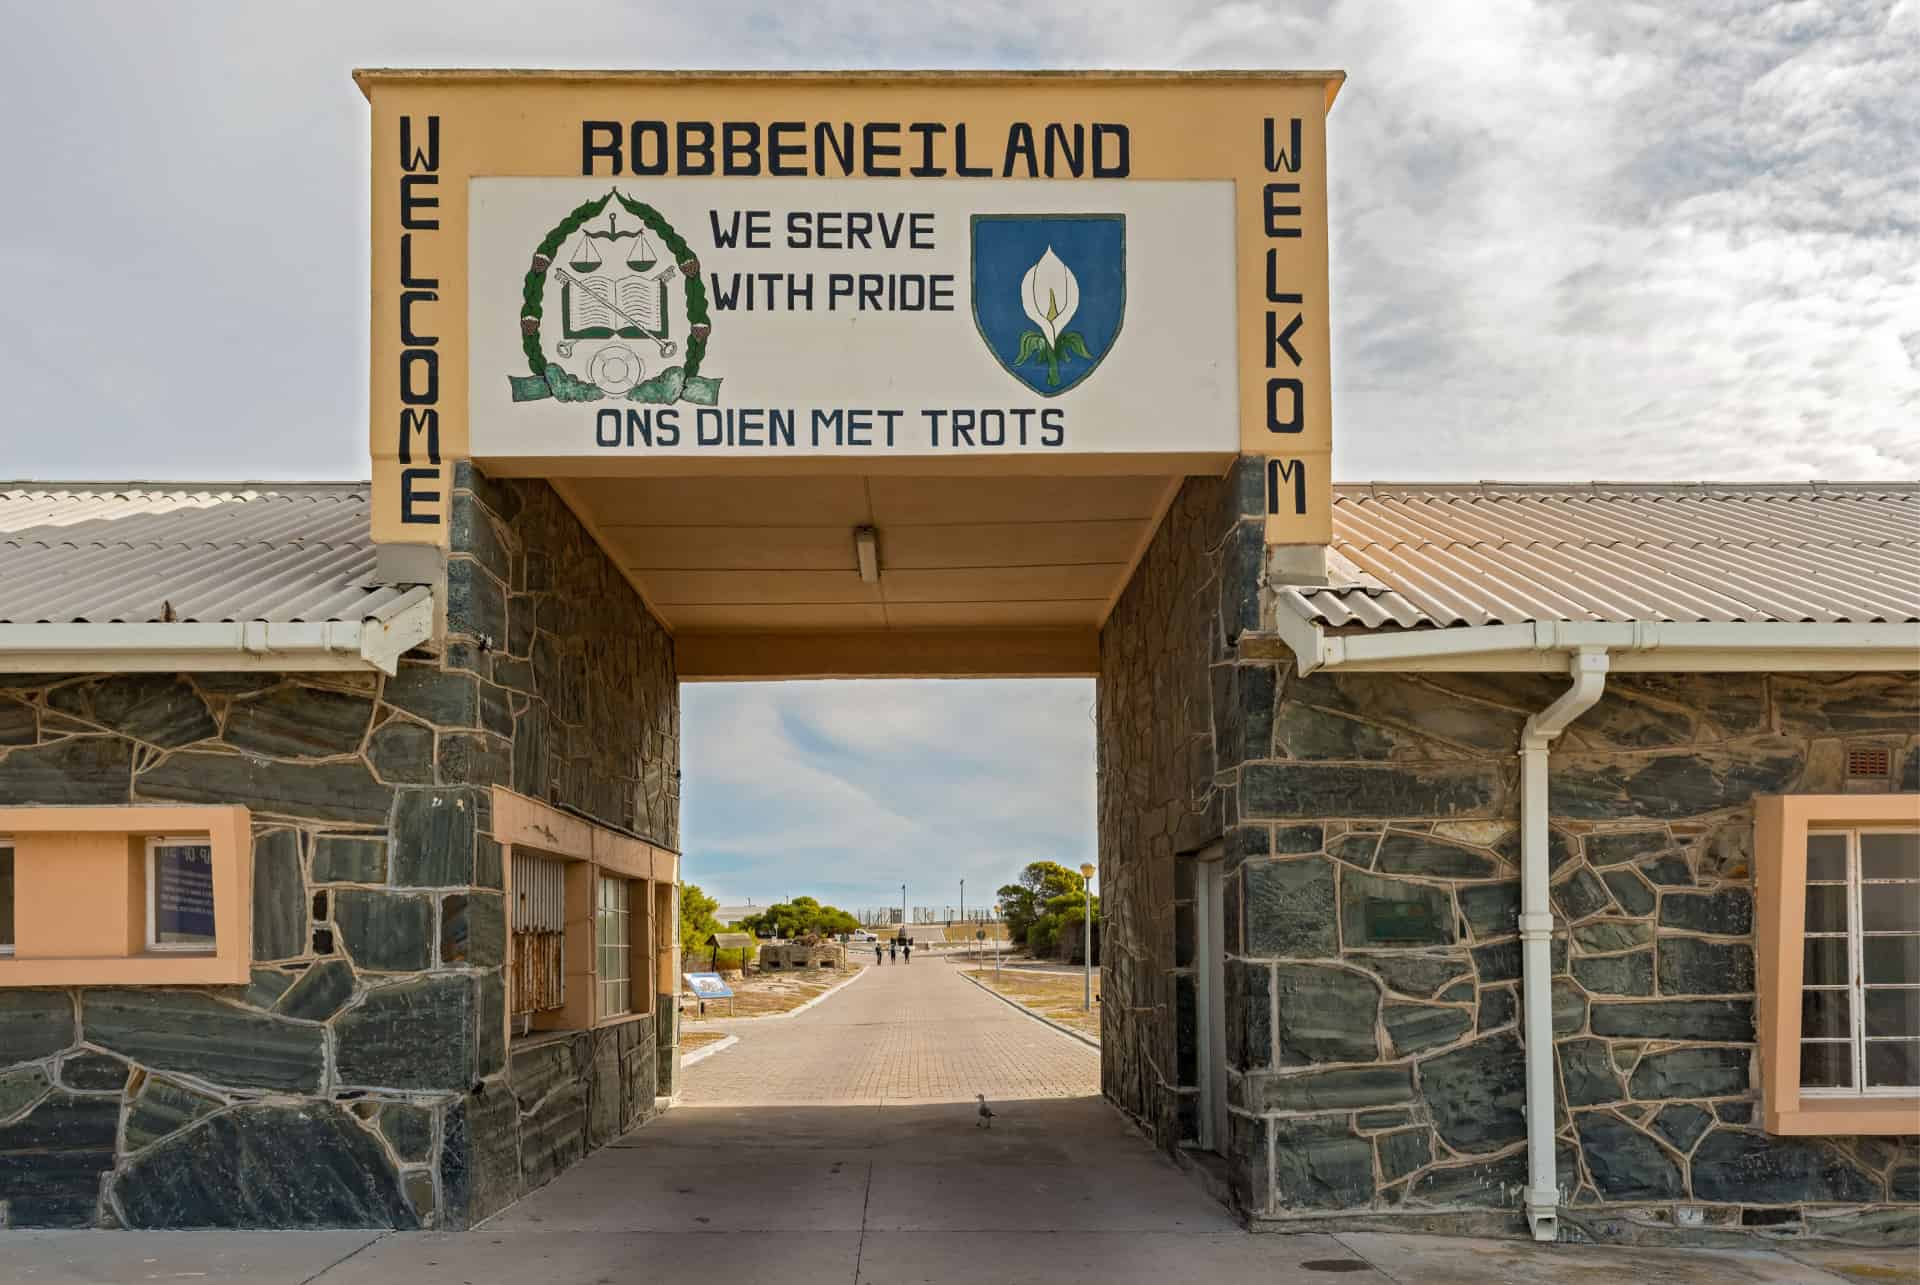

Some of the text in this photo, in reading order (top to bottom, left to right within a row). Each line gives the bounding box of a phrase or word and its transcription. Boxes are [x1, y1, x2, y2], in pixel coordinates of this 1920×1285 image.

[581, 119, 1131, 178] ROBBENEILAND
[709, 210, 935, 250] WE SERVE
[710, 272, 954, 311] WITH PRIDE
[1263, 117, 1307, 515] WELKOM
[398, 115, 442, 525] WELCOME
[596, 408, 1064, 447] ONS DIEN MET TROTS
